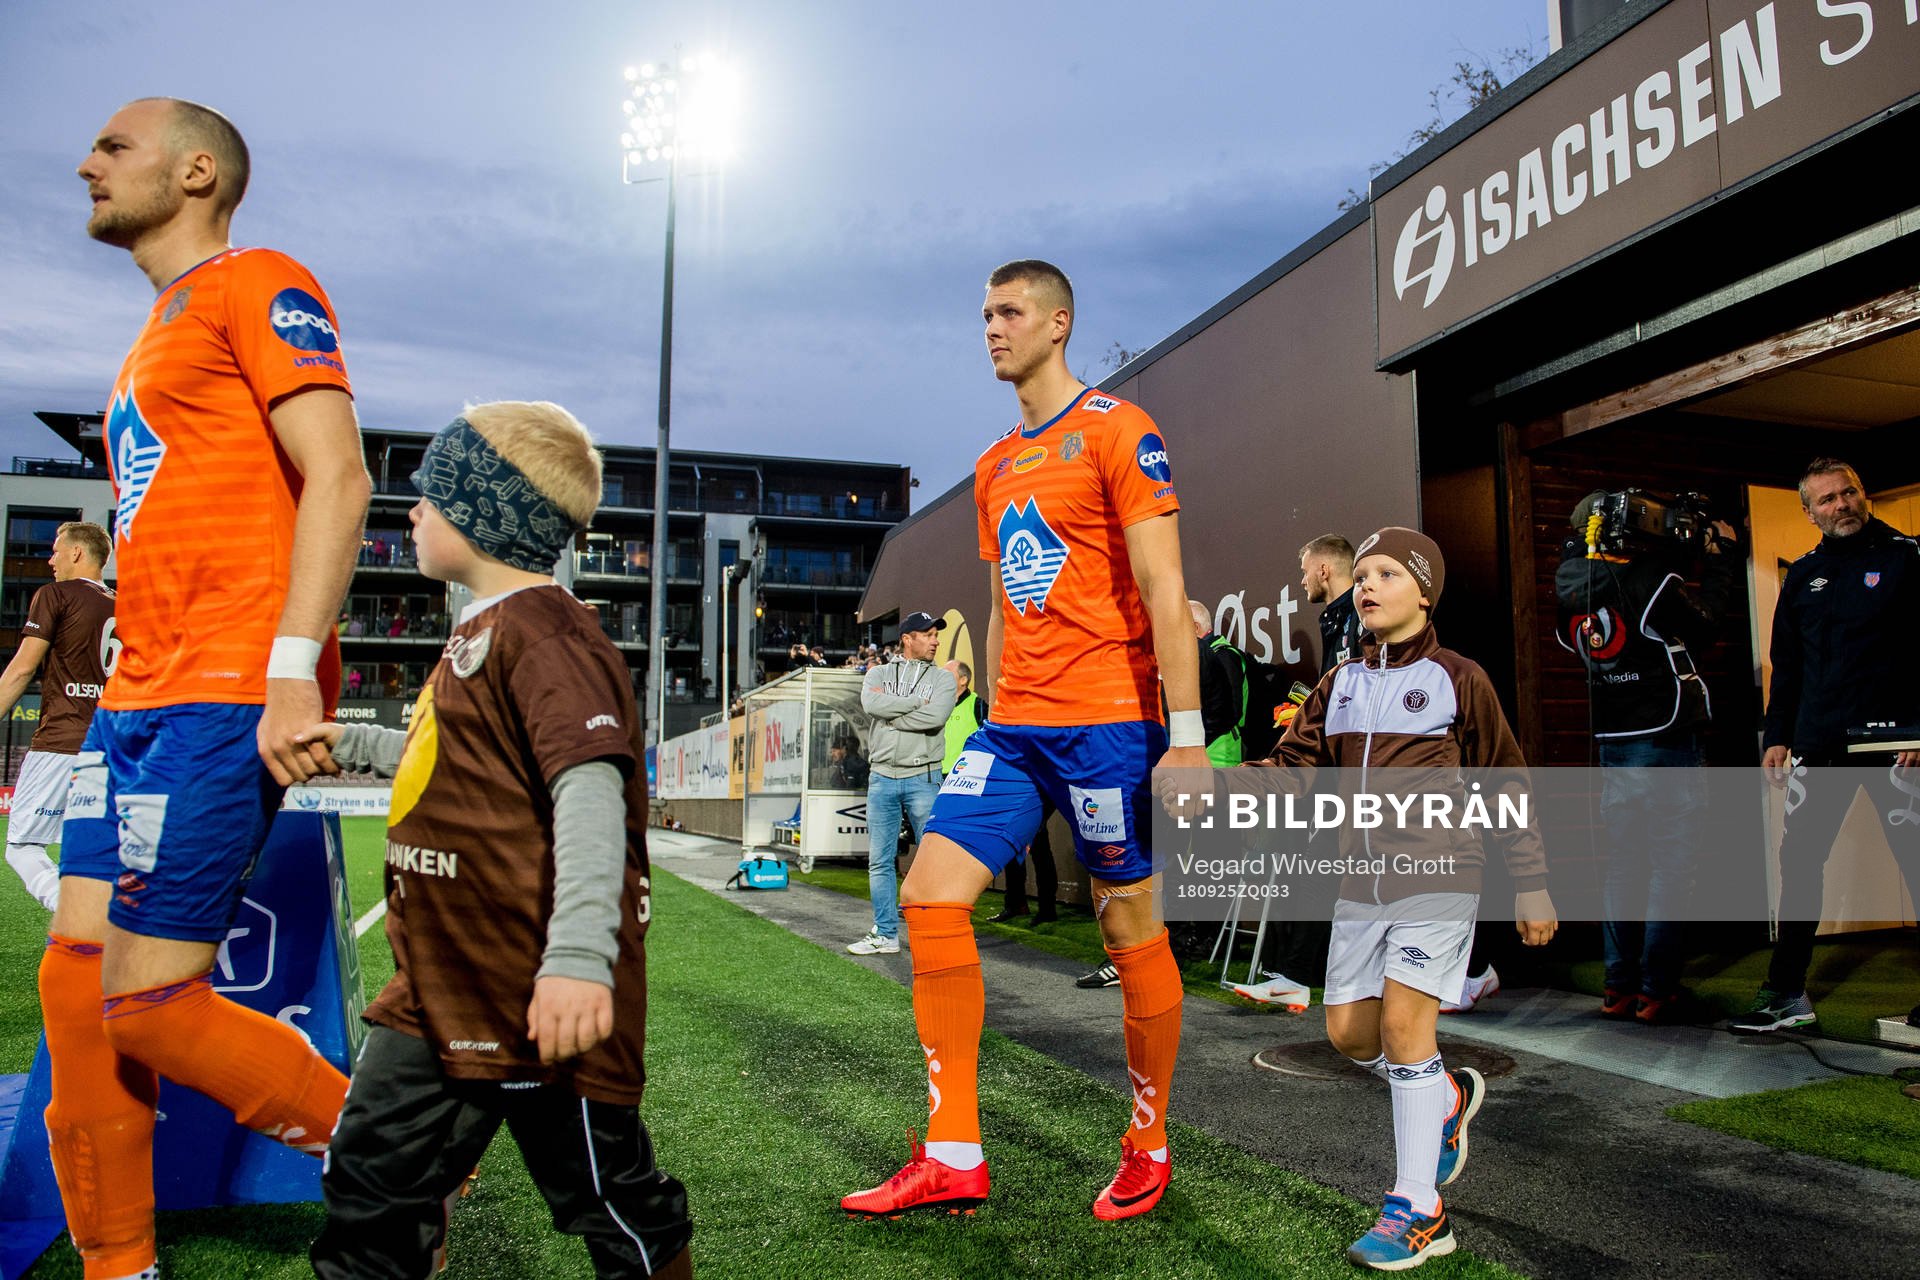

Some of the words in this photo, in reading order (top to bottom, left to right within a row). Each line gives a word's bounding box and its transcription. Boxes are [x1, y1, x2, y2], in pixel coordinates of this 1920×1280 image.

[1463, 1, 1782, 269] ISACHSEN
[1407, 559, 1432, 587] umbro
[100, 616, 124, 678] 6
[1213, 584, 1301, 665] Øst
[65, 682, 104, 699] OLSEN
[1401, 956, 1425, 969] umbro
